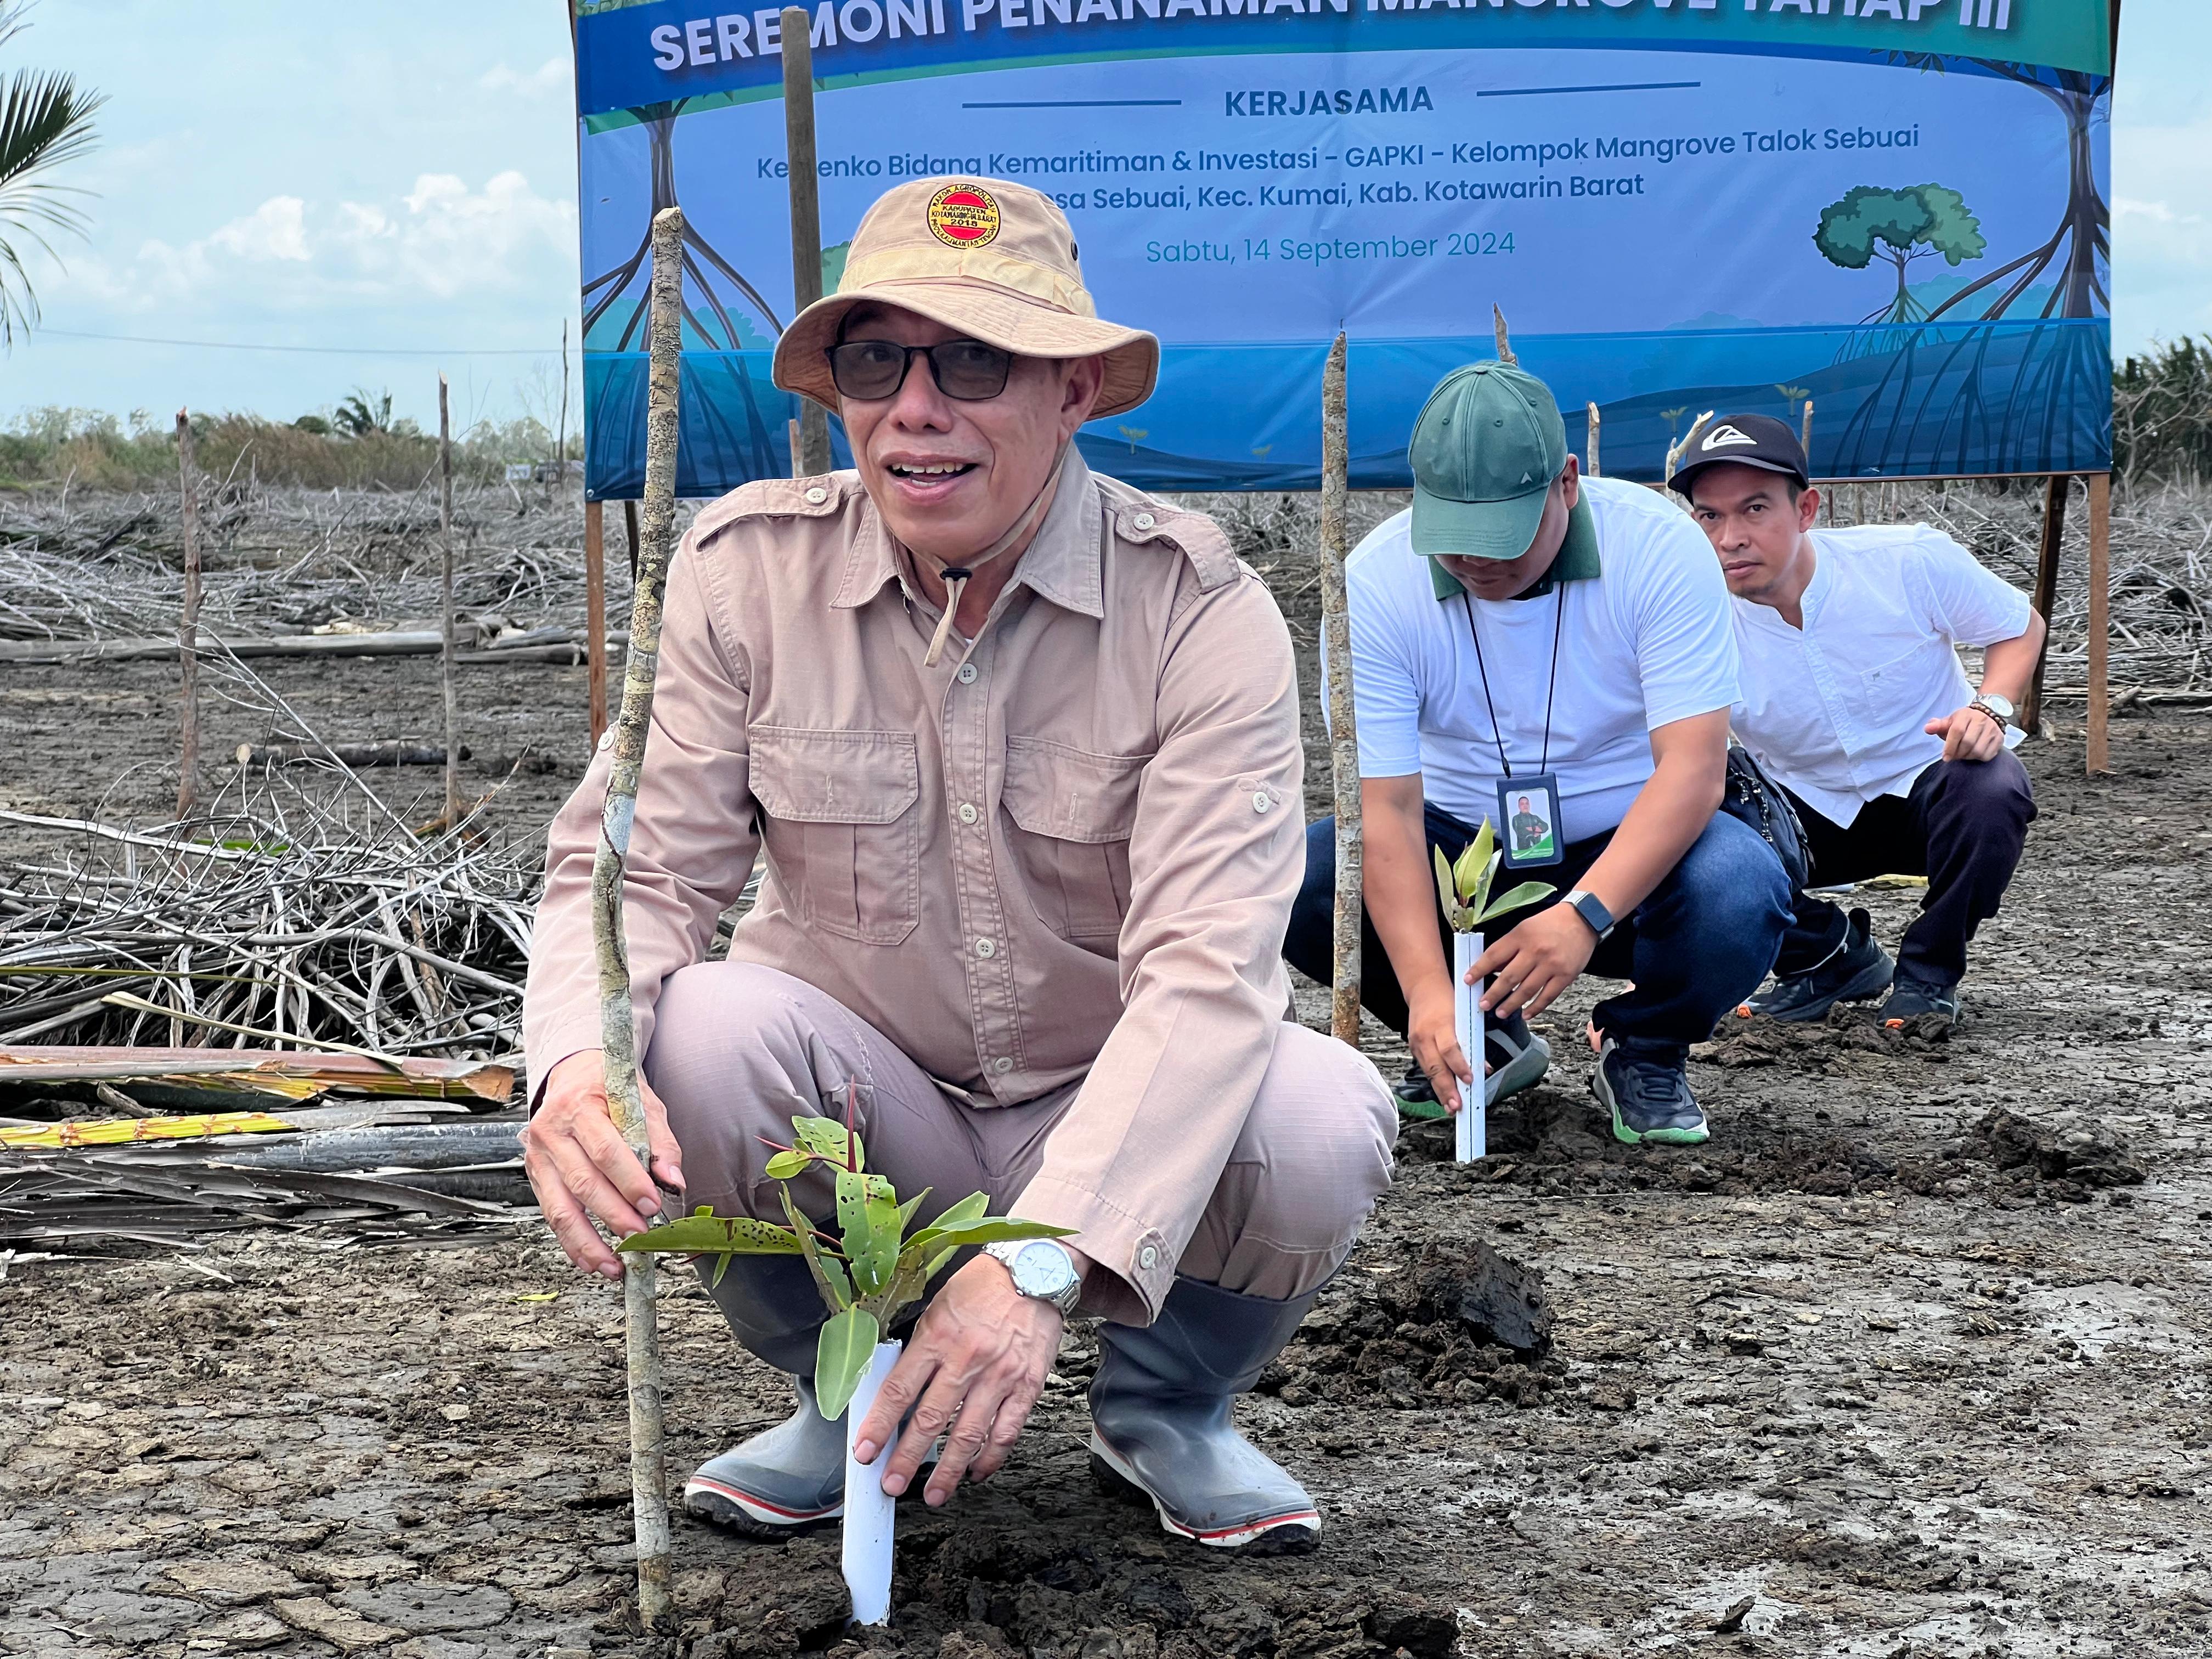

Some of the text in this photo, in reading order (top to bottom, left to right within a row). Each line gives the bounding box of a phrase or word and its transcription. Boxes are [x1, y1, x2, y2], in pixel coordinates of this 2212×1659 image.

[1226, 86, 1434, 116] KERJASAMA
[758, 155, 882, 178] Keenko
[990, 150, 1164, 173] Kemaritiman
[1172, 150, 1192, 171] &
[1199, 146, 1317, 170] Investasi
[1346, 145, 1423, 167] GAPKI
[1453, 138, 1589, 167] Kelompok
[1596, 137, 1735, 163] Mangrove
[1742, 128, 1817, 152] Talok
[1824, 124, 1919, 149] Sebuai
[1093, 185, 1191, 211] Sebuai,
[1199, 187, 1253, 207] Kec.
[1261, 182, 1352, 208] Kumai,
[1361, 181, 1418, 204] Kab.
[1426, 175, 1562, 201] Kotawarin
[1571, 174, 1644, 196] Barat
[943, 205, 986, 215] KABUPATEN
[1147, 233, 1516, 267] Sabtu, 14 September 2024
